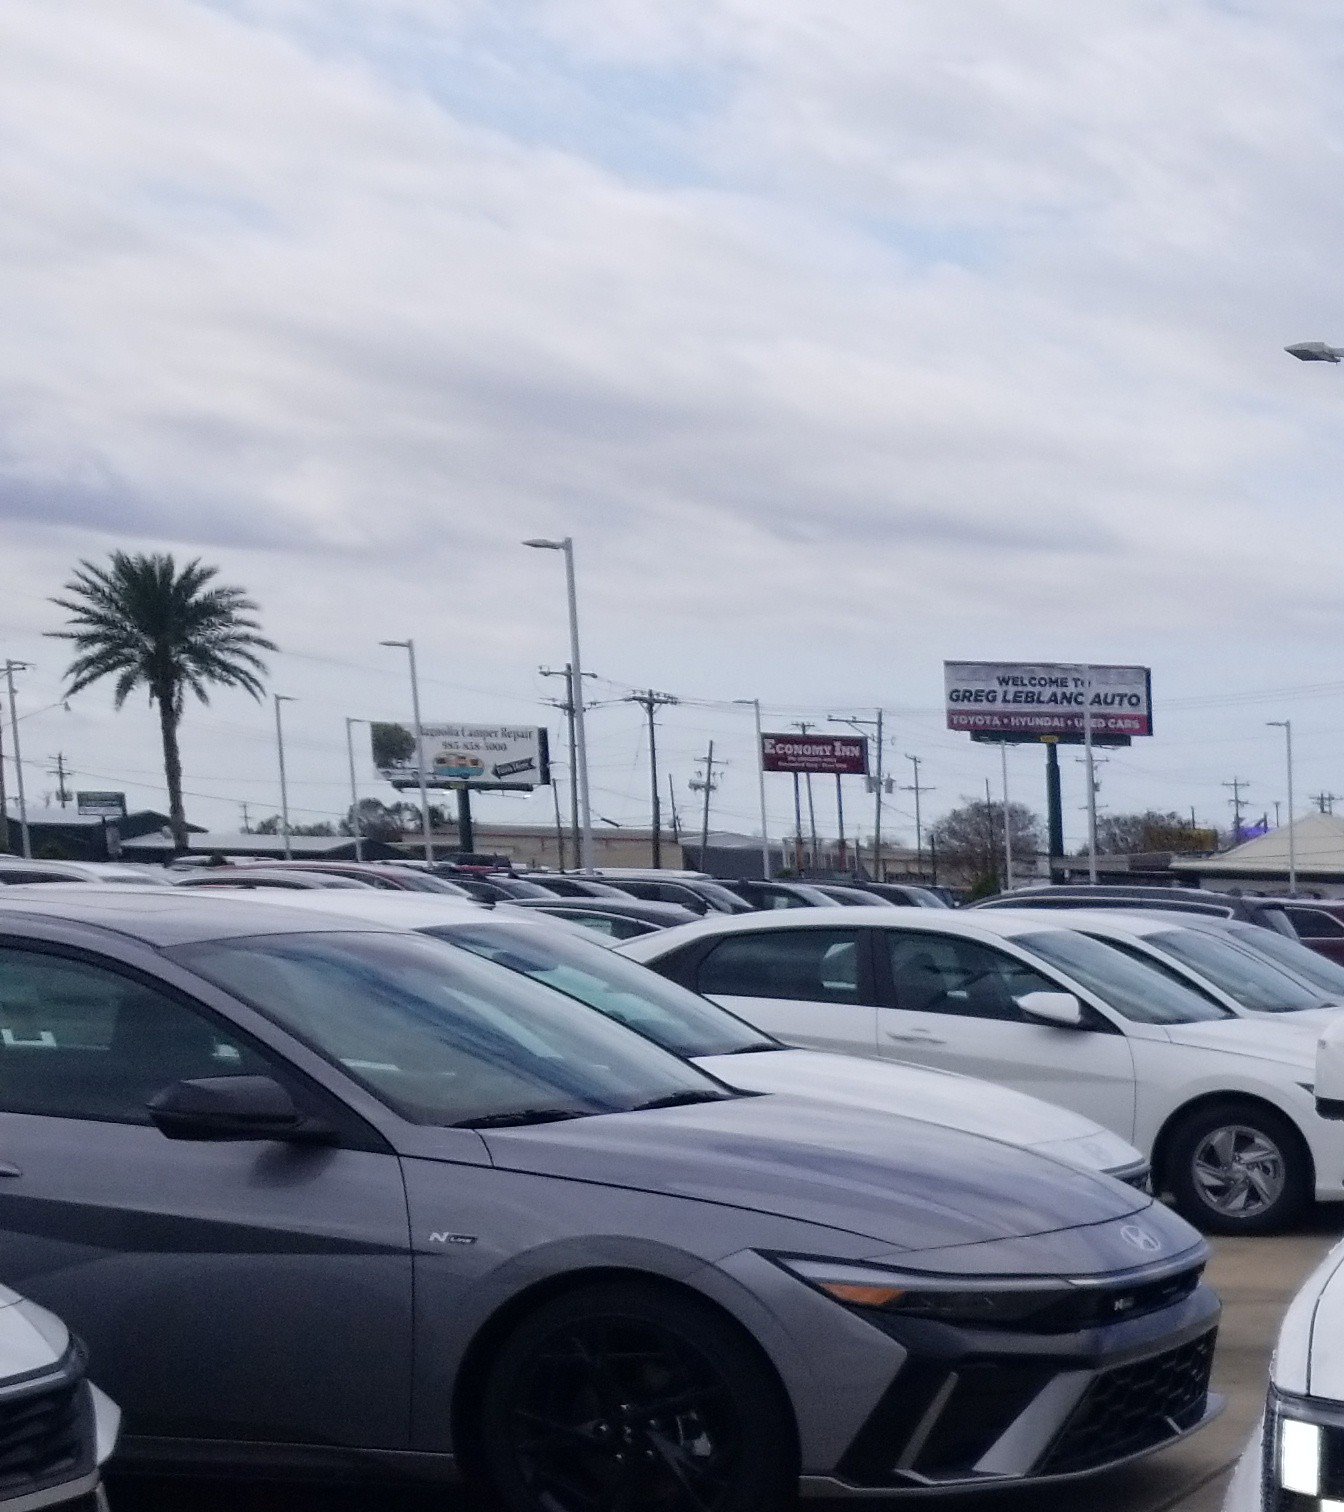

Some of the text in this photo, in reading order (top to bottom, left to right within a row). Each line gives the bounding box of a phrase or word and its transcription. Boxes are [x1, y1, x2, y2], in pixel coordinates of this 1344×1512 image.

[996, 675, 1069, 688] WELCOME
[949, 688, 1141, 707] GREG LEBLANC AUTO
[951, 715, 1141, 729] TOYOTA HYUNDAI UED CARS
[419, 724, 459, 738] agnolia
[500, 727, 533, 742] Repair
[763, 738, 860, 757] ECONOMY INN
